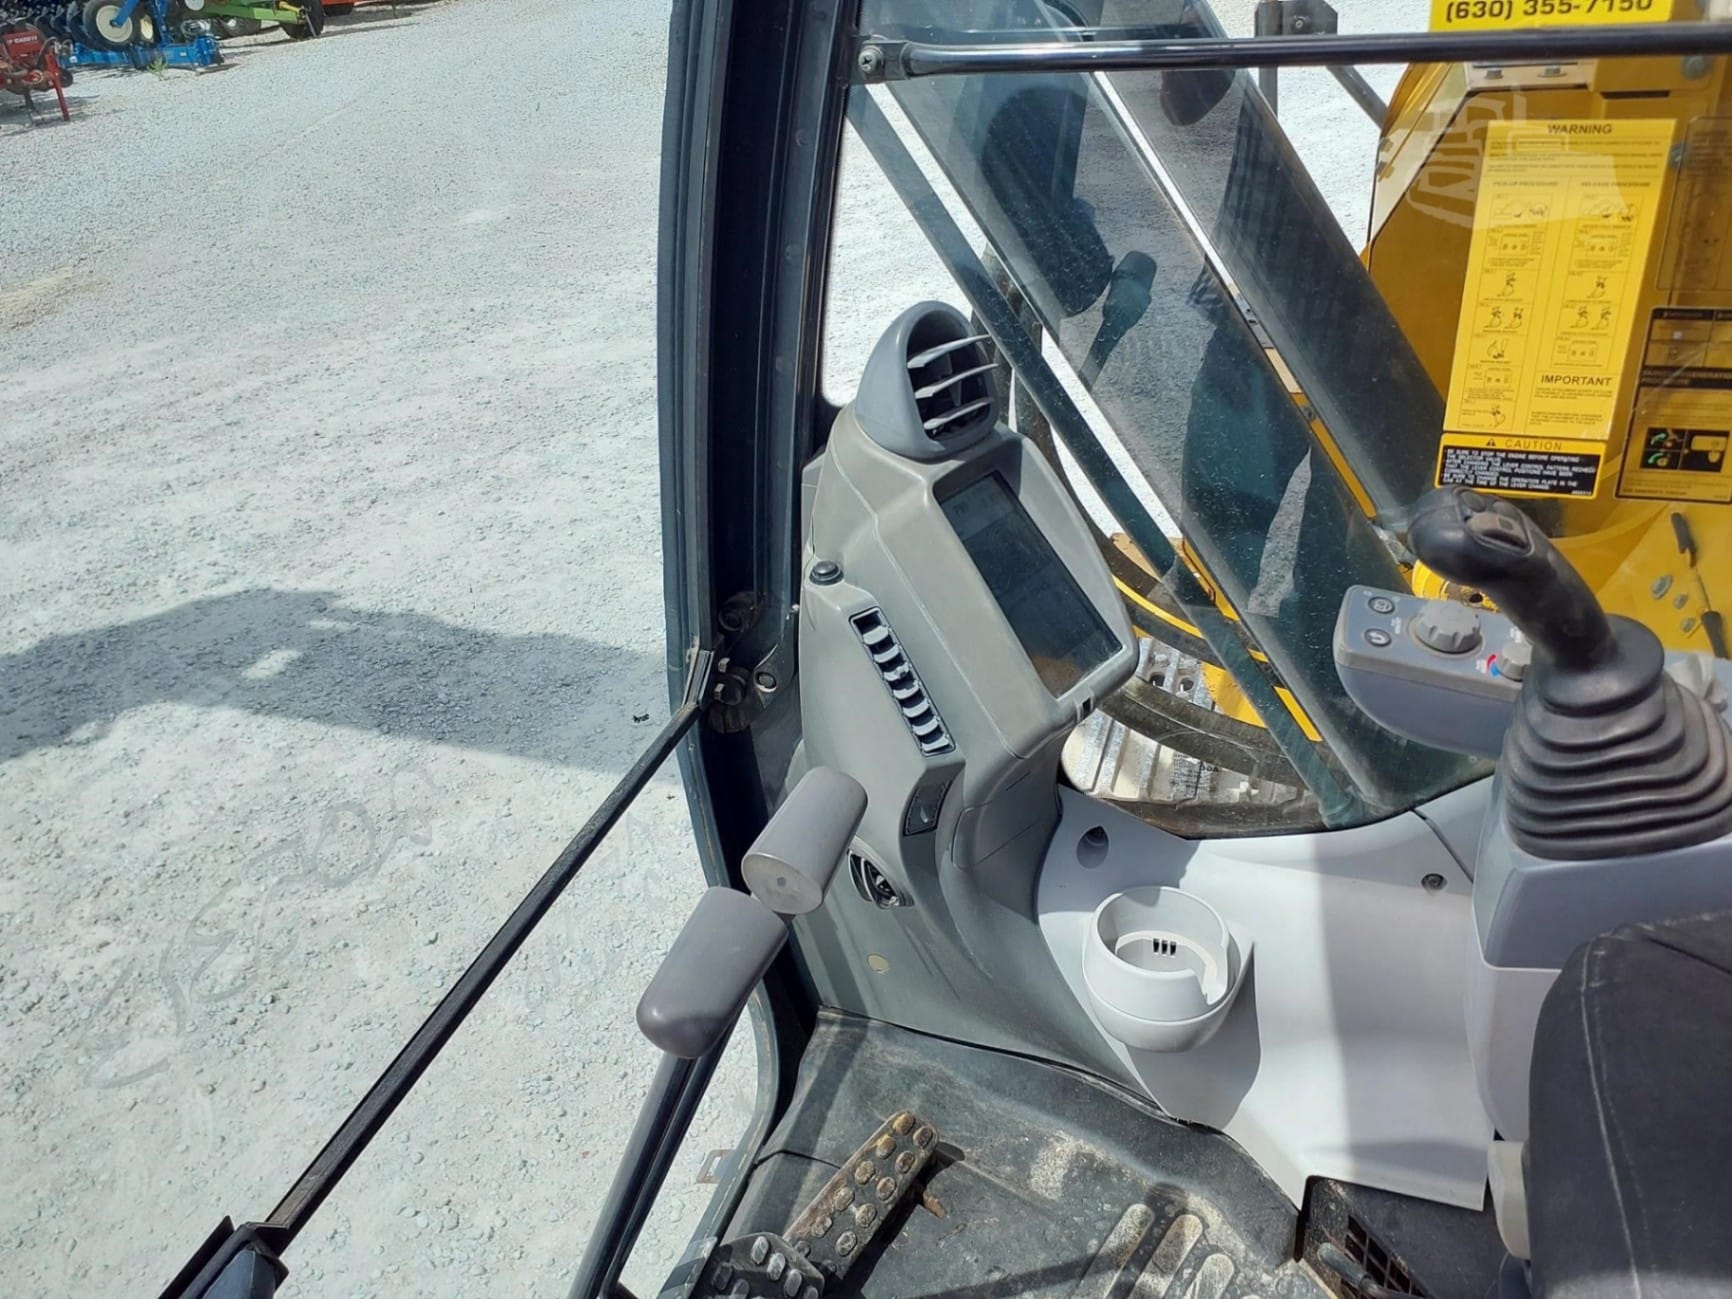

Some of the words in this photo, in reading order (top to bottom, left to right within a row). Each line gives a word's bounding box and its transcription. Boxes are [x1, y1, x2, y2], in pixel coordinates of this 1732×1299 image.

[1446, 0, 1513, 22] (630)
[1547, 123, 1613, 135] WARNING
[1540, 374, 1613, 386] IMPORTANT
[1504, 438, 1562, 451] CAUTION
